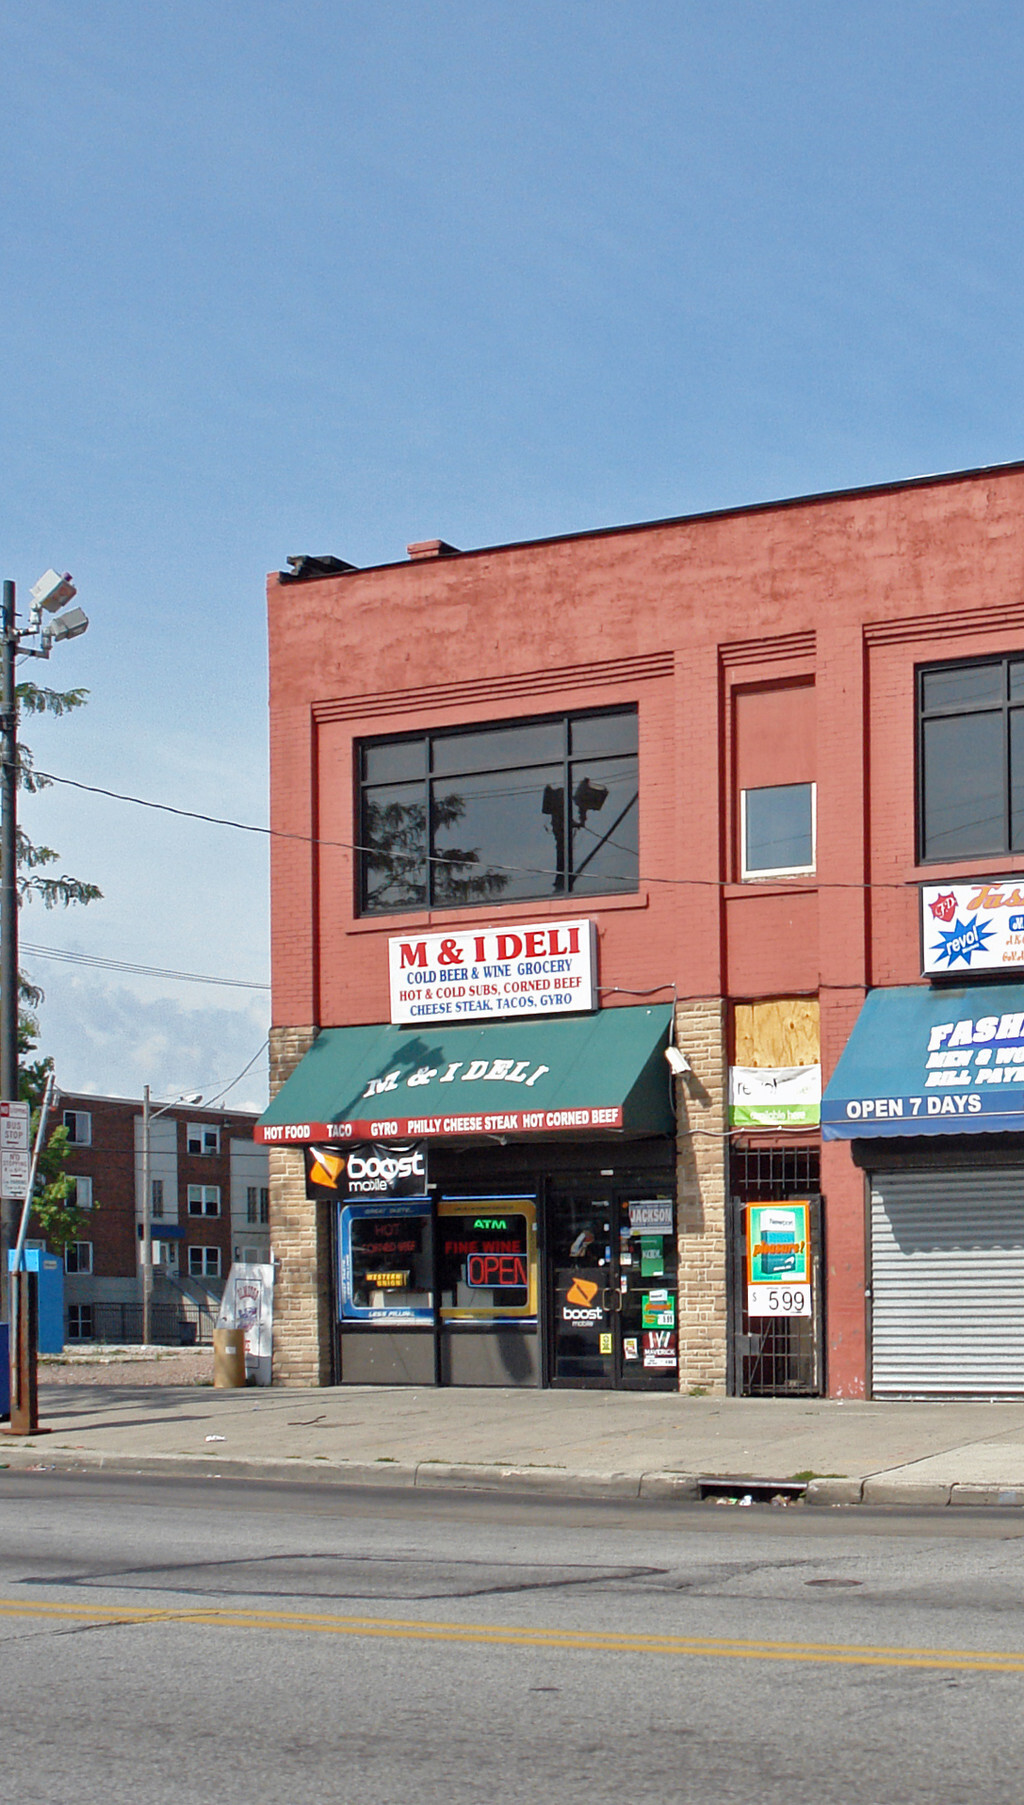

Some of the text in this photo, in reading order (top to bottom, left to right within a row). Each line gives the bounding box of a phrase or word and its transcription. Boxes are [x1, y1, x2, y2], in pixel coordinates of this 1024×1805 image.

[400, 927, 581, 969] M & I DELI
[946, 925, 979, 956] revol
[407, 959, 573, 985] COLD BEER & WINE GROCERY
[399, 976, 583, 1002] HOT & COLD SUBS, CORNED BEEF
[410, 993, 572, 1017] CHEESE STEAK, TACOS, GYRO
[924, 1049, 974, 1069] MEN
[974, 1048, 992, 1066] &
[363, 1058, 550, 1098] M & I DELI
[924, 1068, 972, 1088] BILL
[846, 1097, 903, 1119] OPEN
[909, 1098, 922, 1115] 7
[927, 1094, 982, 1115] DAYS
[4, 1131, 23, 1139] STOP
[6, 1121, 22, 1130] BUS
[264, 1109, 619, 1139] HOT FOOD TACO GYRO PHILLY CHEESE STEAK HOT CORNED BEEF
[347, 1151, 425, 1179] boost
[348, 1178, 388, 1193] mobile
[473, 1219, 507, 1230] ATM
[630, 1208, 673, 1223] JACKSON
[444, 1240, 522, 1254] FINE WINE
[753, 1240, 805, 1258] pleasure!
[469, 1256, 528, 1285] OPEN
[563, 1306, 603, 1320] boost
